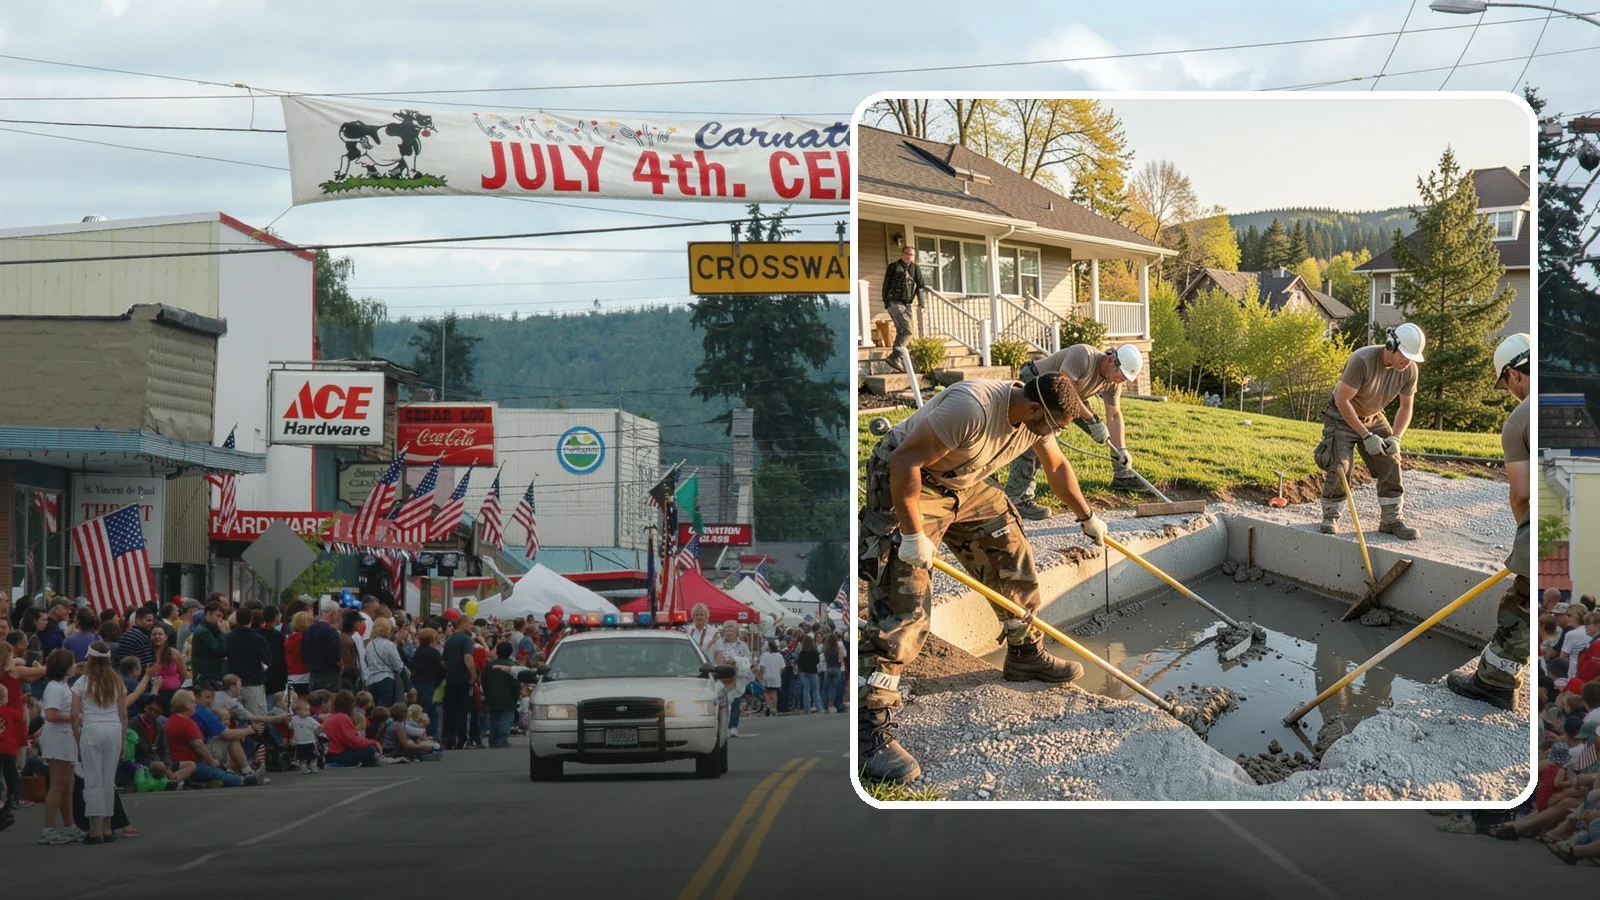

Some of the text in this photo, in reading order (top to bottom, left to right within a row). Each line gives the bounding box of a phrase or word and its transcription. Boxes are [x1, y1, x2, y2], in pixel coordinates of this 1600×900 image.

[481, 140, 604, 191] JULY
[632, 149, 746, 197] 4th.
[696, 254, 850, 280] CROSSWA
[282, 379, 374, 420] ACE
[405, 409, 452, 421] CEDAR
[283, 420, 371, 437] Hardware
[416, 427, 476, 447] Coca-Cola
[95, 485, 124, 495] Vincent
[126, 486, 135, 495] de
[137, 486, 155, 495] Paul
[212, 516, 330, 535] HARDARE
[688, 526, 741, 535] CRNATION
[699, 535, 730, 544] GLASS
